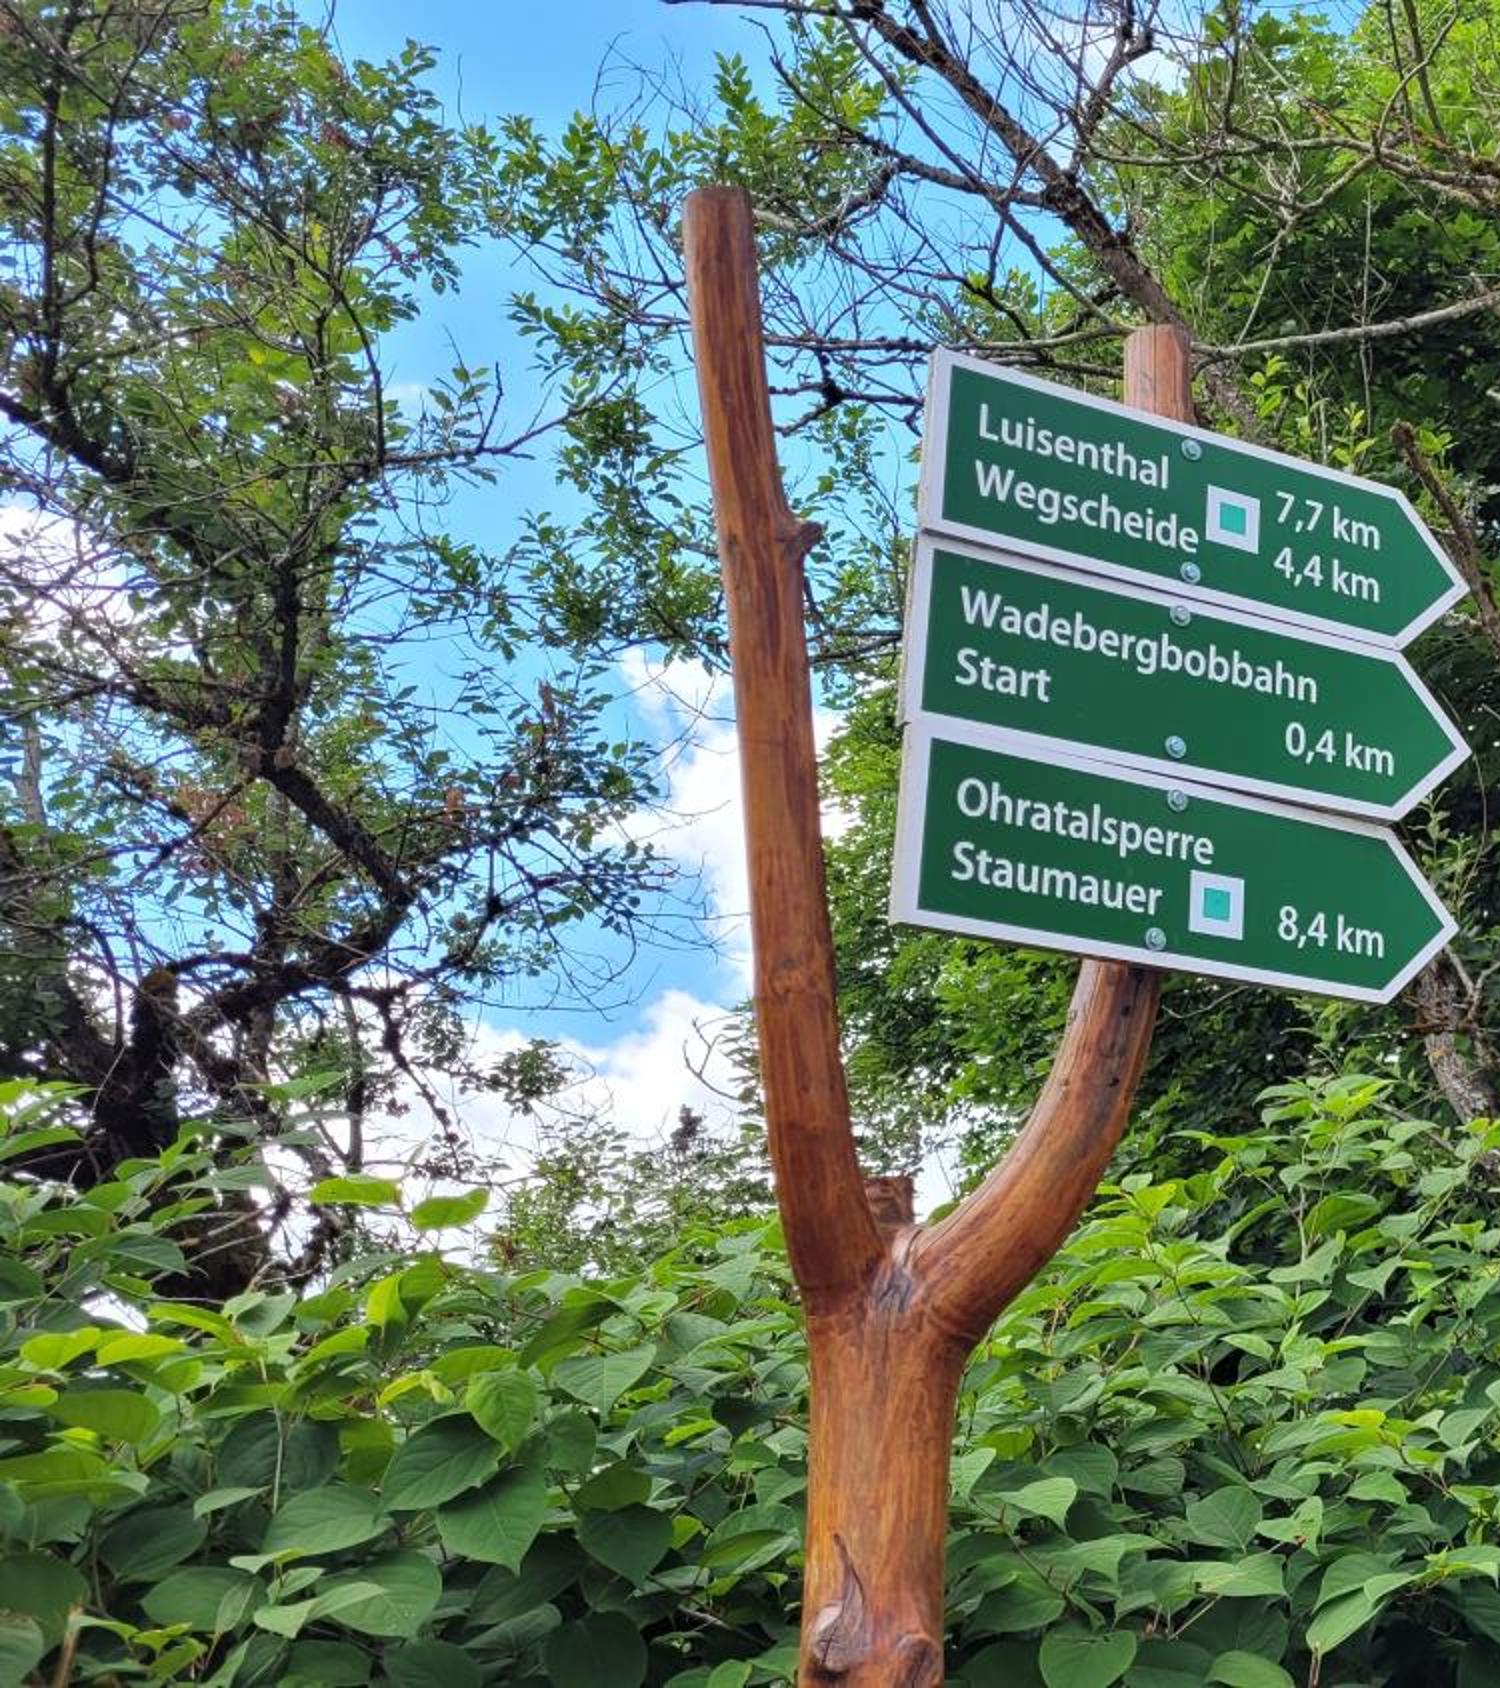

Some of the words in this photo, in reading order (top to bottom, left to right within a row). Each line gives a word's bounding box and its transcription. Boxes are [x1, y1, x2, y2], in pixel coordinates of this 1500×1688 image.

[978, 403, 1169, 489] Luisenthal
[975, 460, 1199, 553] Wegscheide
[1276, 491, 1324, 533] 7,7
[1333, 506, 1380, 550] km
[1273, 547, 1324, 589] 4,4
[1332, 559, 1380, 603] km
[955, 647, 1051, 703] Start
[961, 586, 1317, 704] Wadebergbobbahn
[1285, 722, 1337, 765] 0,4
[1345, 732, 1394, 776] km
[957, 778, 1214, 865] Ohratalsperre
[951, 841, 1163, 916] Staumauer
[1278, 905, 1328, 949] 8,4
[1337, 914, 1384, 958] km
